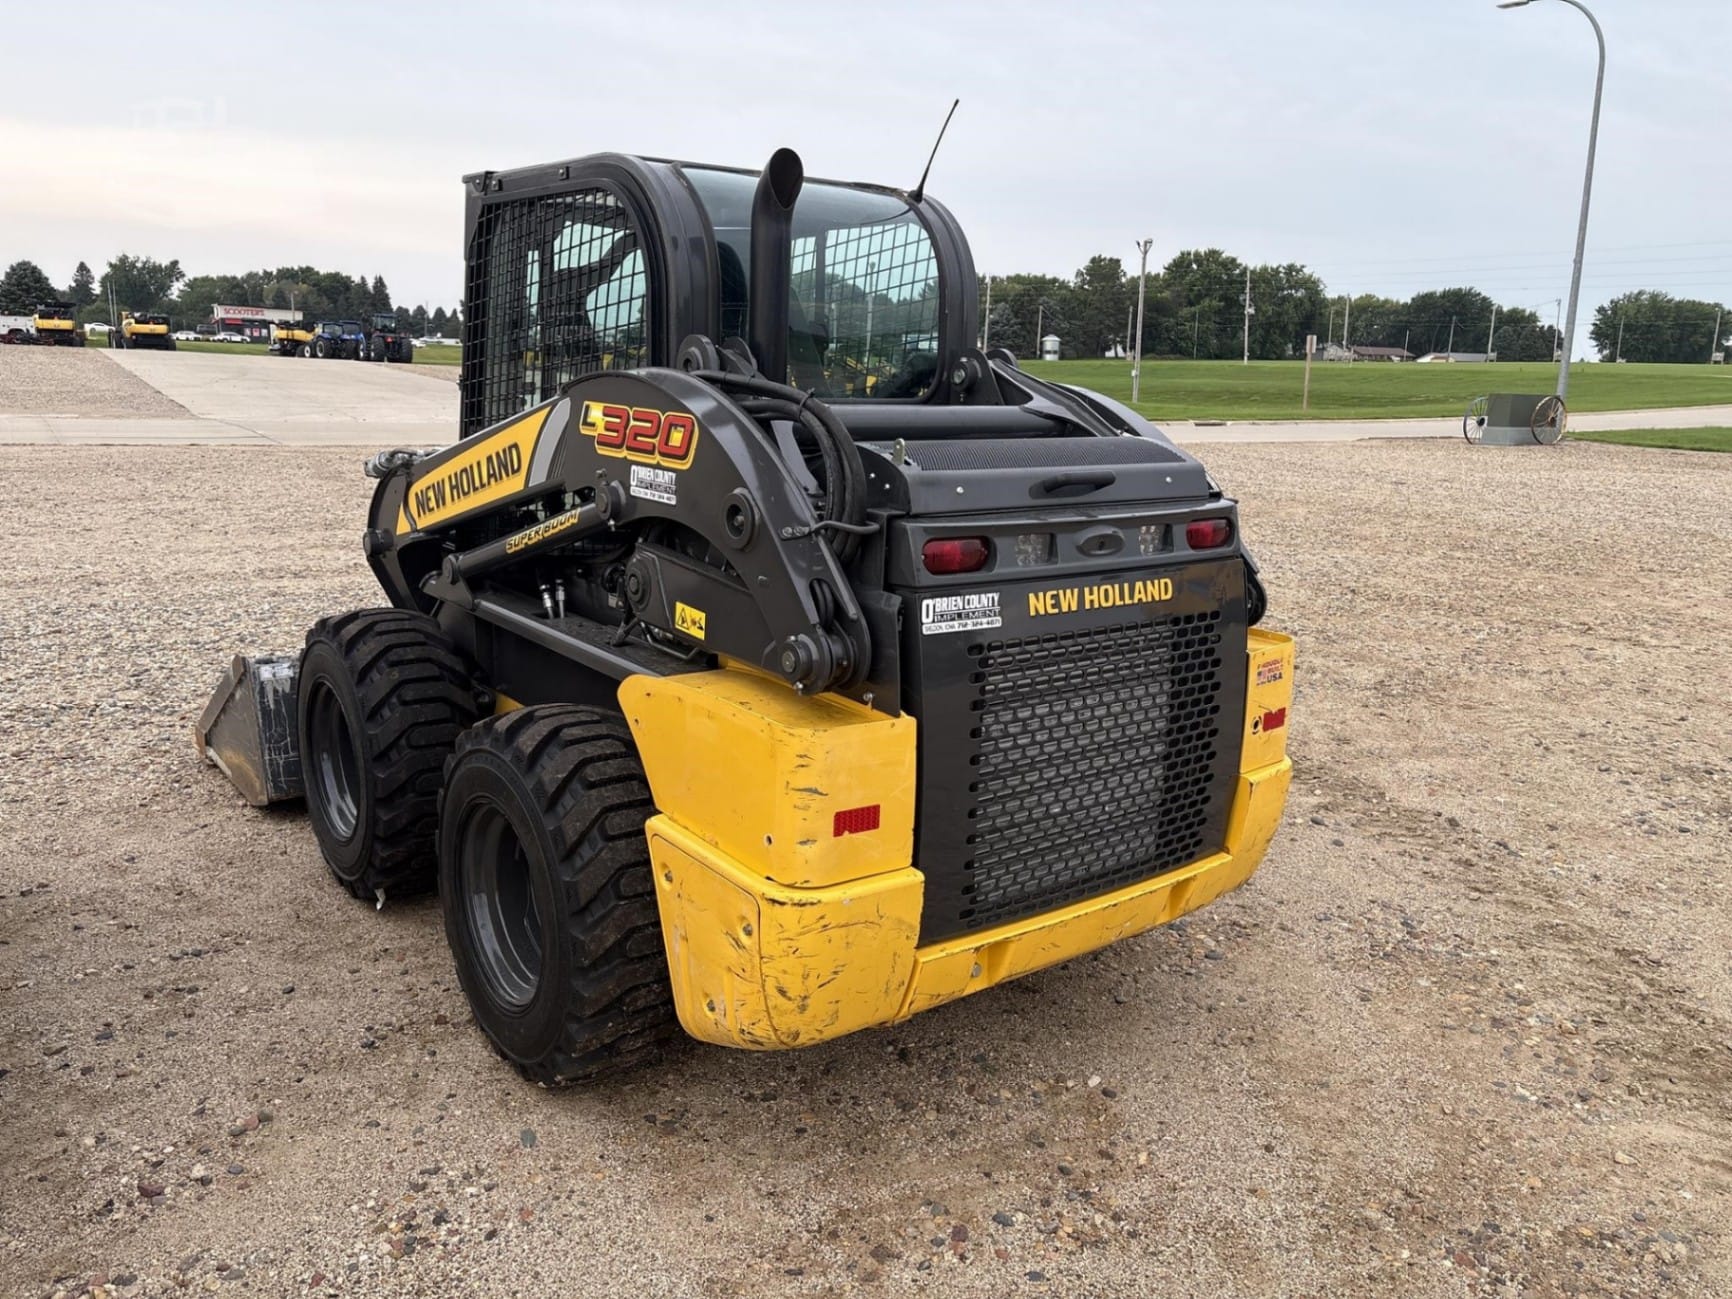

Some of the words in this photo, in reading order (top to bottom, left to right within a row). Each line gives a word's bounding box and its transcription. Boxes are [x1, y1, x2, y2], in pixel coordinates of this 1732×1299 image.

[580, 401, 698, 469] L320
[414, 474, 447, 518] NEW
[448, 442, 522, 502] HOLLAND
[922, 595, 964, 624] O'BRIEN
[964, 592, 1000, 609] COUNTY
[1028, 588, 1079, 617] NEW
[1084, 578, 1174, 610] HOLLAND
[934, 609, 1001, 623] IMPLEMENT
[1266, 672, 1283, 683] USA
